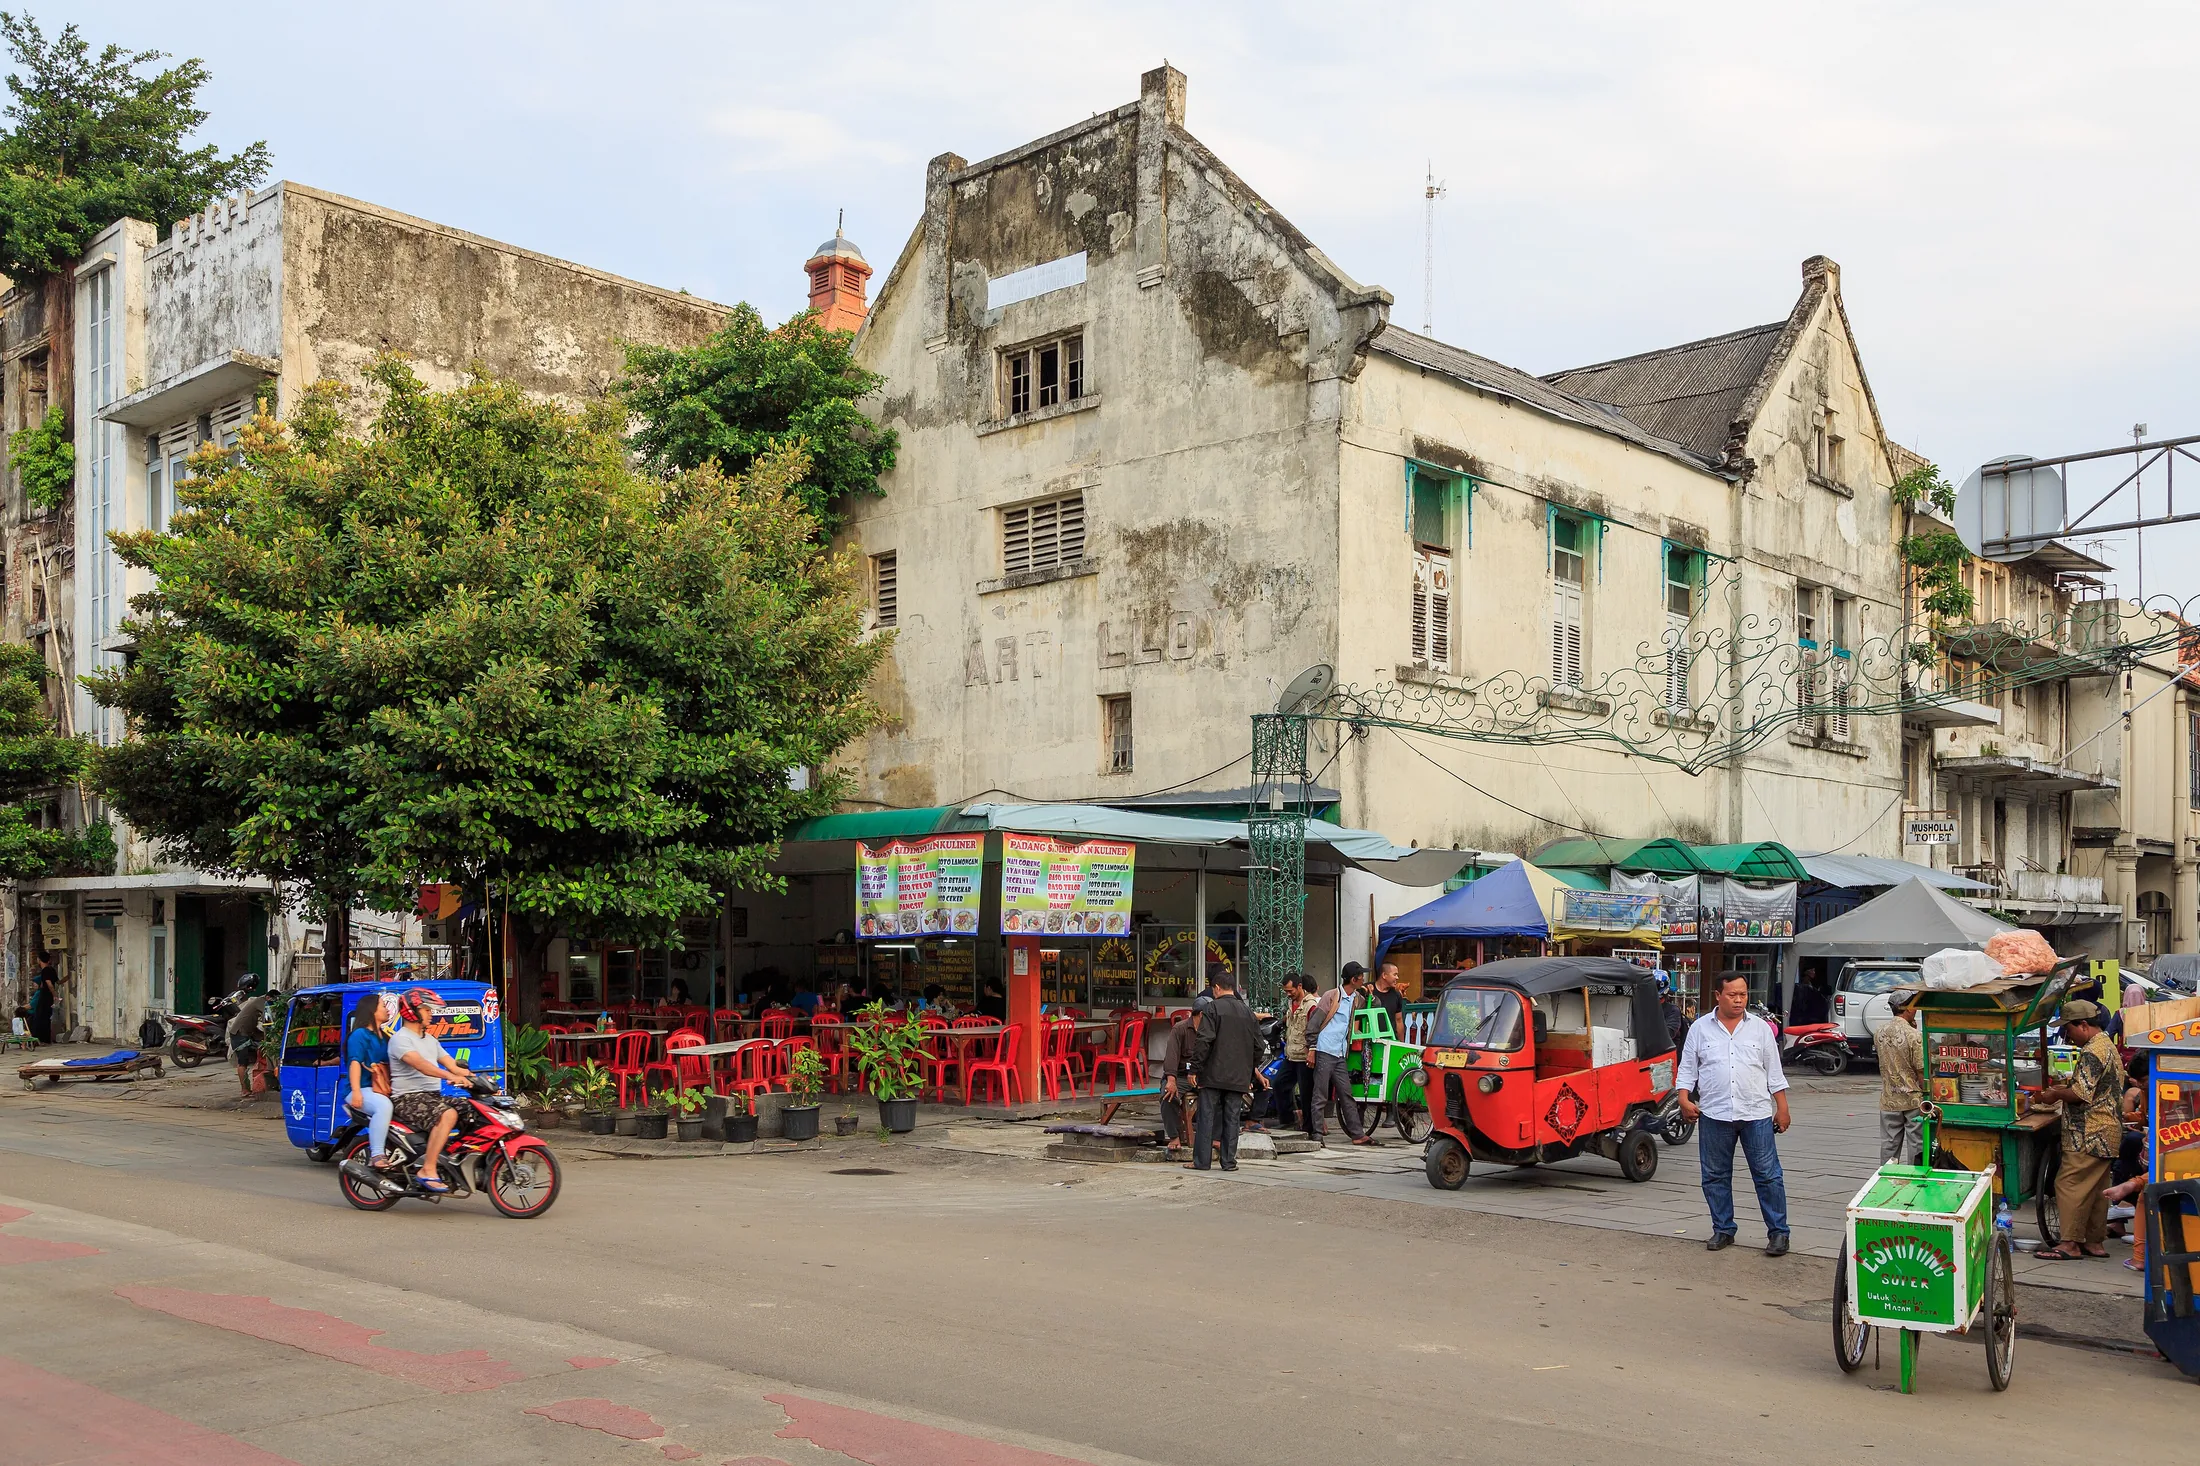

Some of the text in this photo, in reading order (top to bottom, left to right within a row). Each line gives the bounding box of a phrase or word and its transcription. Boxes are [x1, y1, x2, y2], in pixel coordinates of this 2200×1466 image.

[1912, 824, 1954, 832] MUSHOLLA
[1915, 833, 1951, 842] TOILET
[864, 849, 893, 859] PADAN
[940, 840, 976, 849] KULINER
[1010, 840, 1127, 856] PADANG SDIMPUAN KULINER
[1019, 859, 1041, 867] GORENG
[1048, 873, 1061, 881] BASO
[1097, 938, 1135, 963] ANEKA JUS
[1144, 936, 1173, 973] NASI
[1144, 977, 1180, 985] PUTRI
[1939, 1046, 1988, 1060] BUBUR
[1940, 1061, 1978, 1074] AYAM
[1881, 1273, 1929, 1289] SUPER
